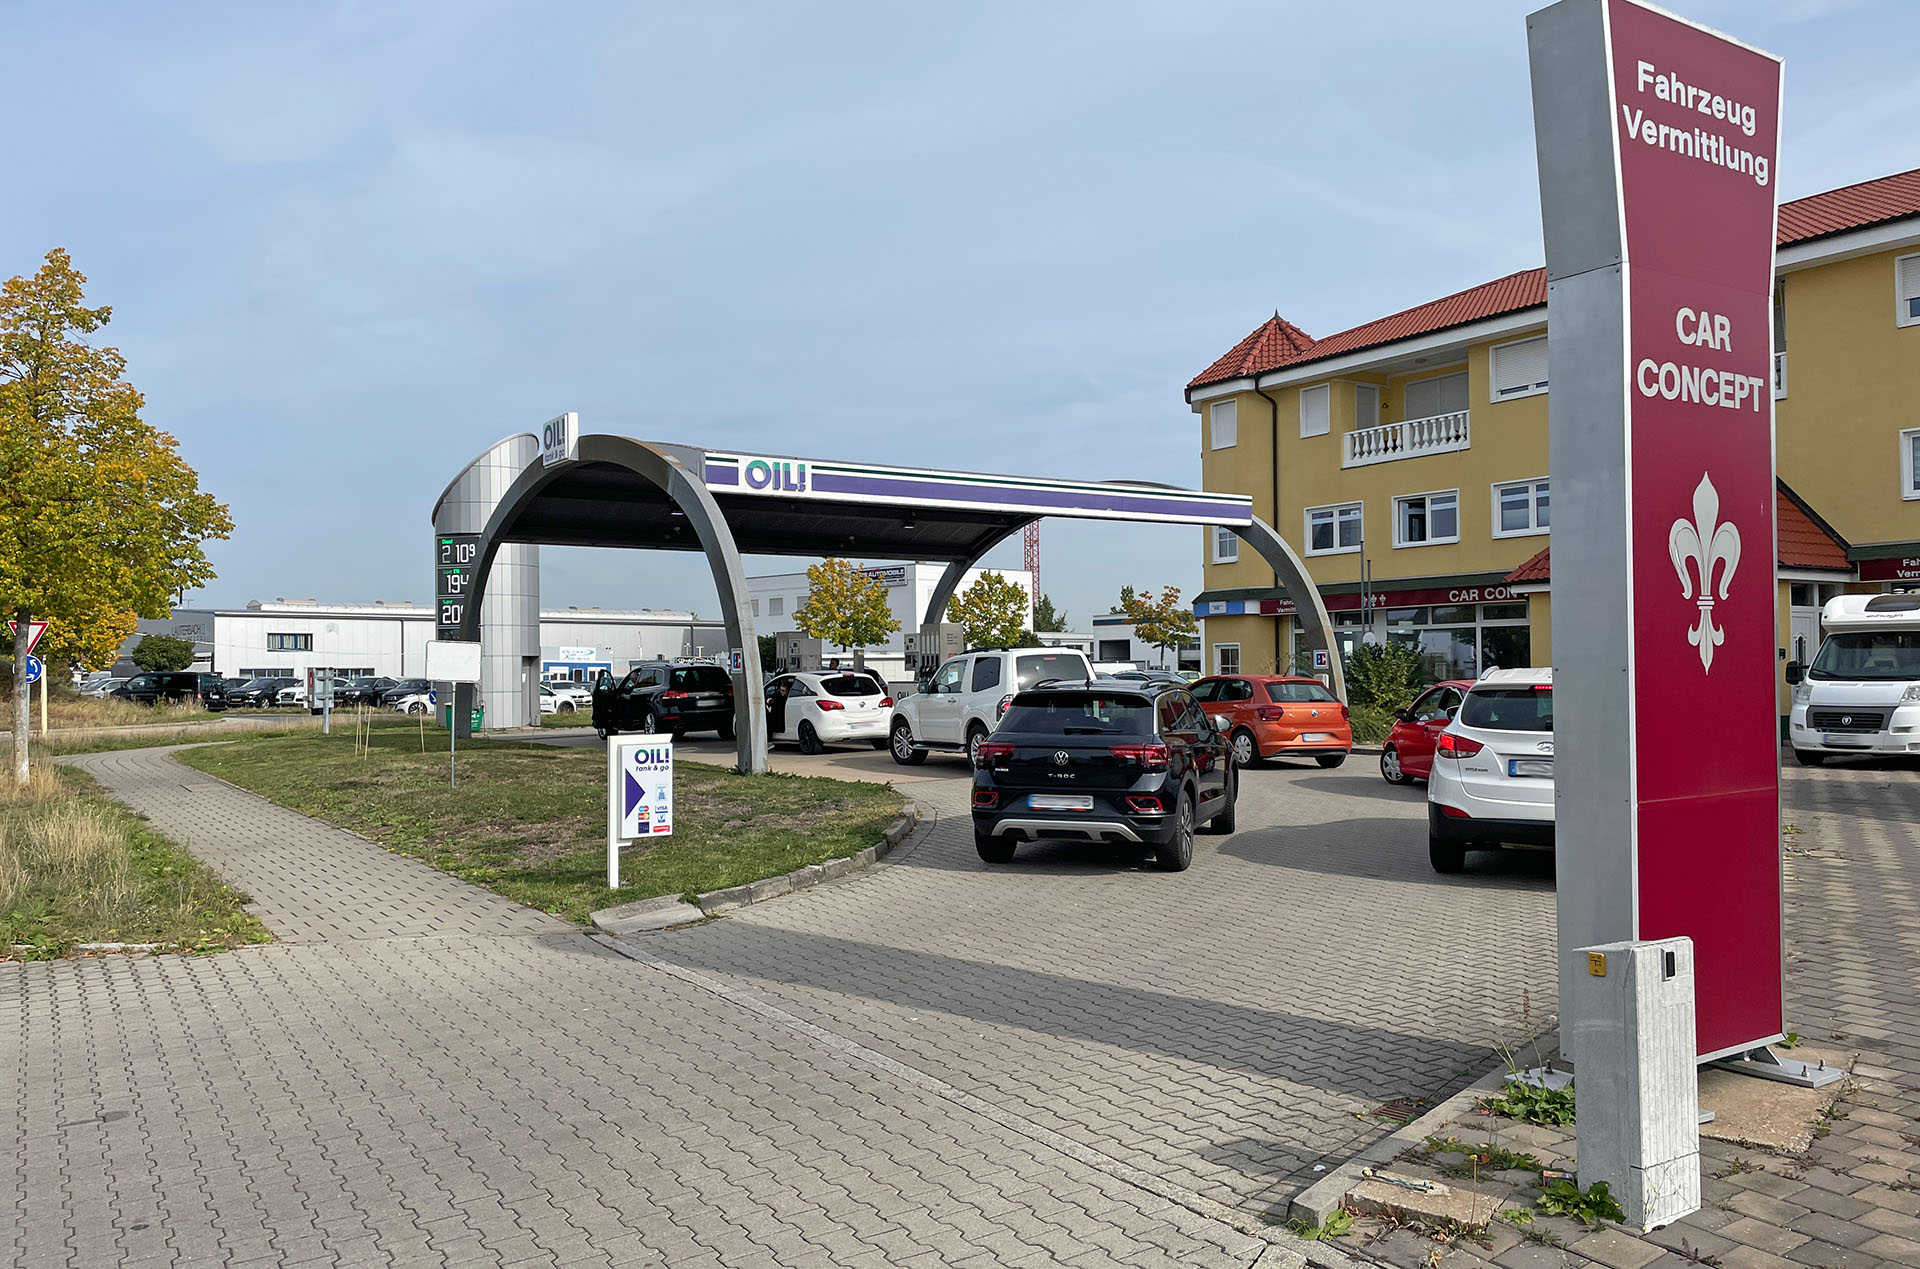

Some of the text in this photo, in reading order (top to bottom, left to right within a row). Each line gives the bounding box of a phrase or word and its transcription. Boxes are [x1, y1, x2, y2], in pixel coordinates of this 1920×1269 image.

[1637, 59, 1756, 136] Fahrzeug
[1622, 104, 1769, 186] Vermittlung
[1676, 307, 1732, 352] CAR
[1637, 358, 1764, 412] CONCEPT
[544, 418, 565, 450] OIL!
[744, 459, 806, 492] OIL!
[1448, 589, 1479, 602] CAR
[634, 748, 670, 765] OIL!
[659, 765, 670, 773] go
